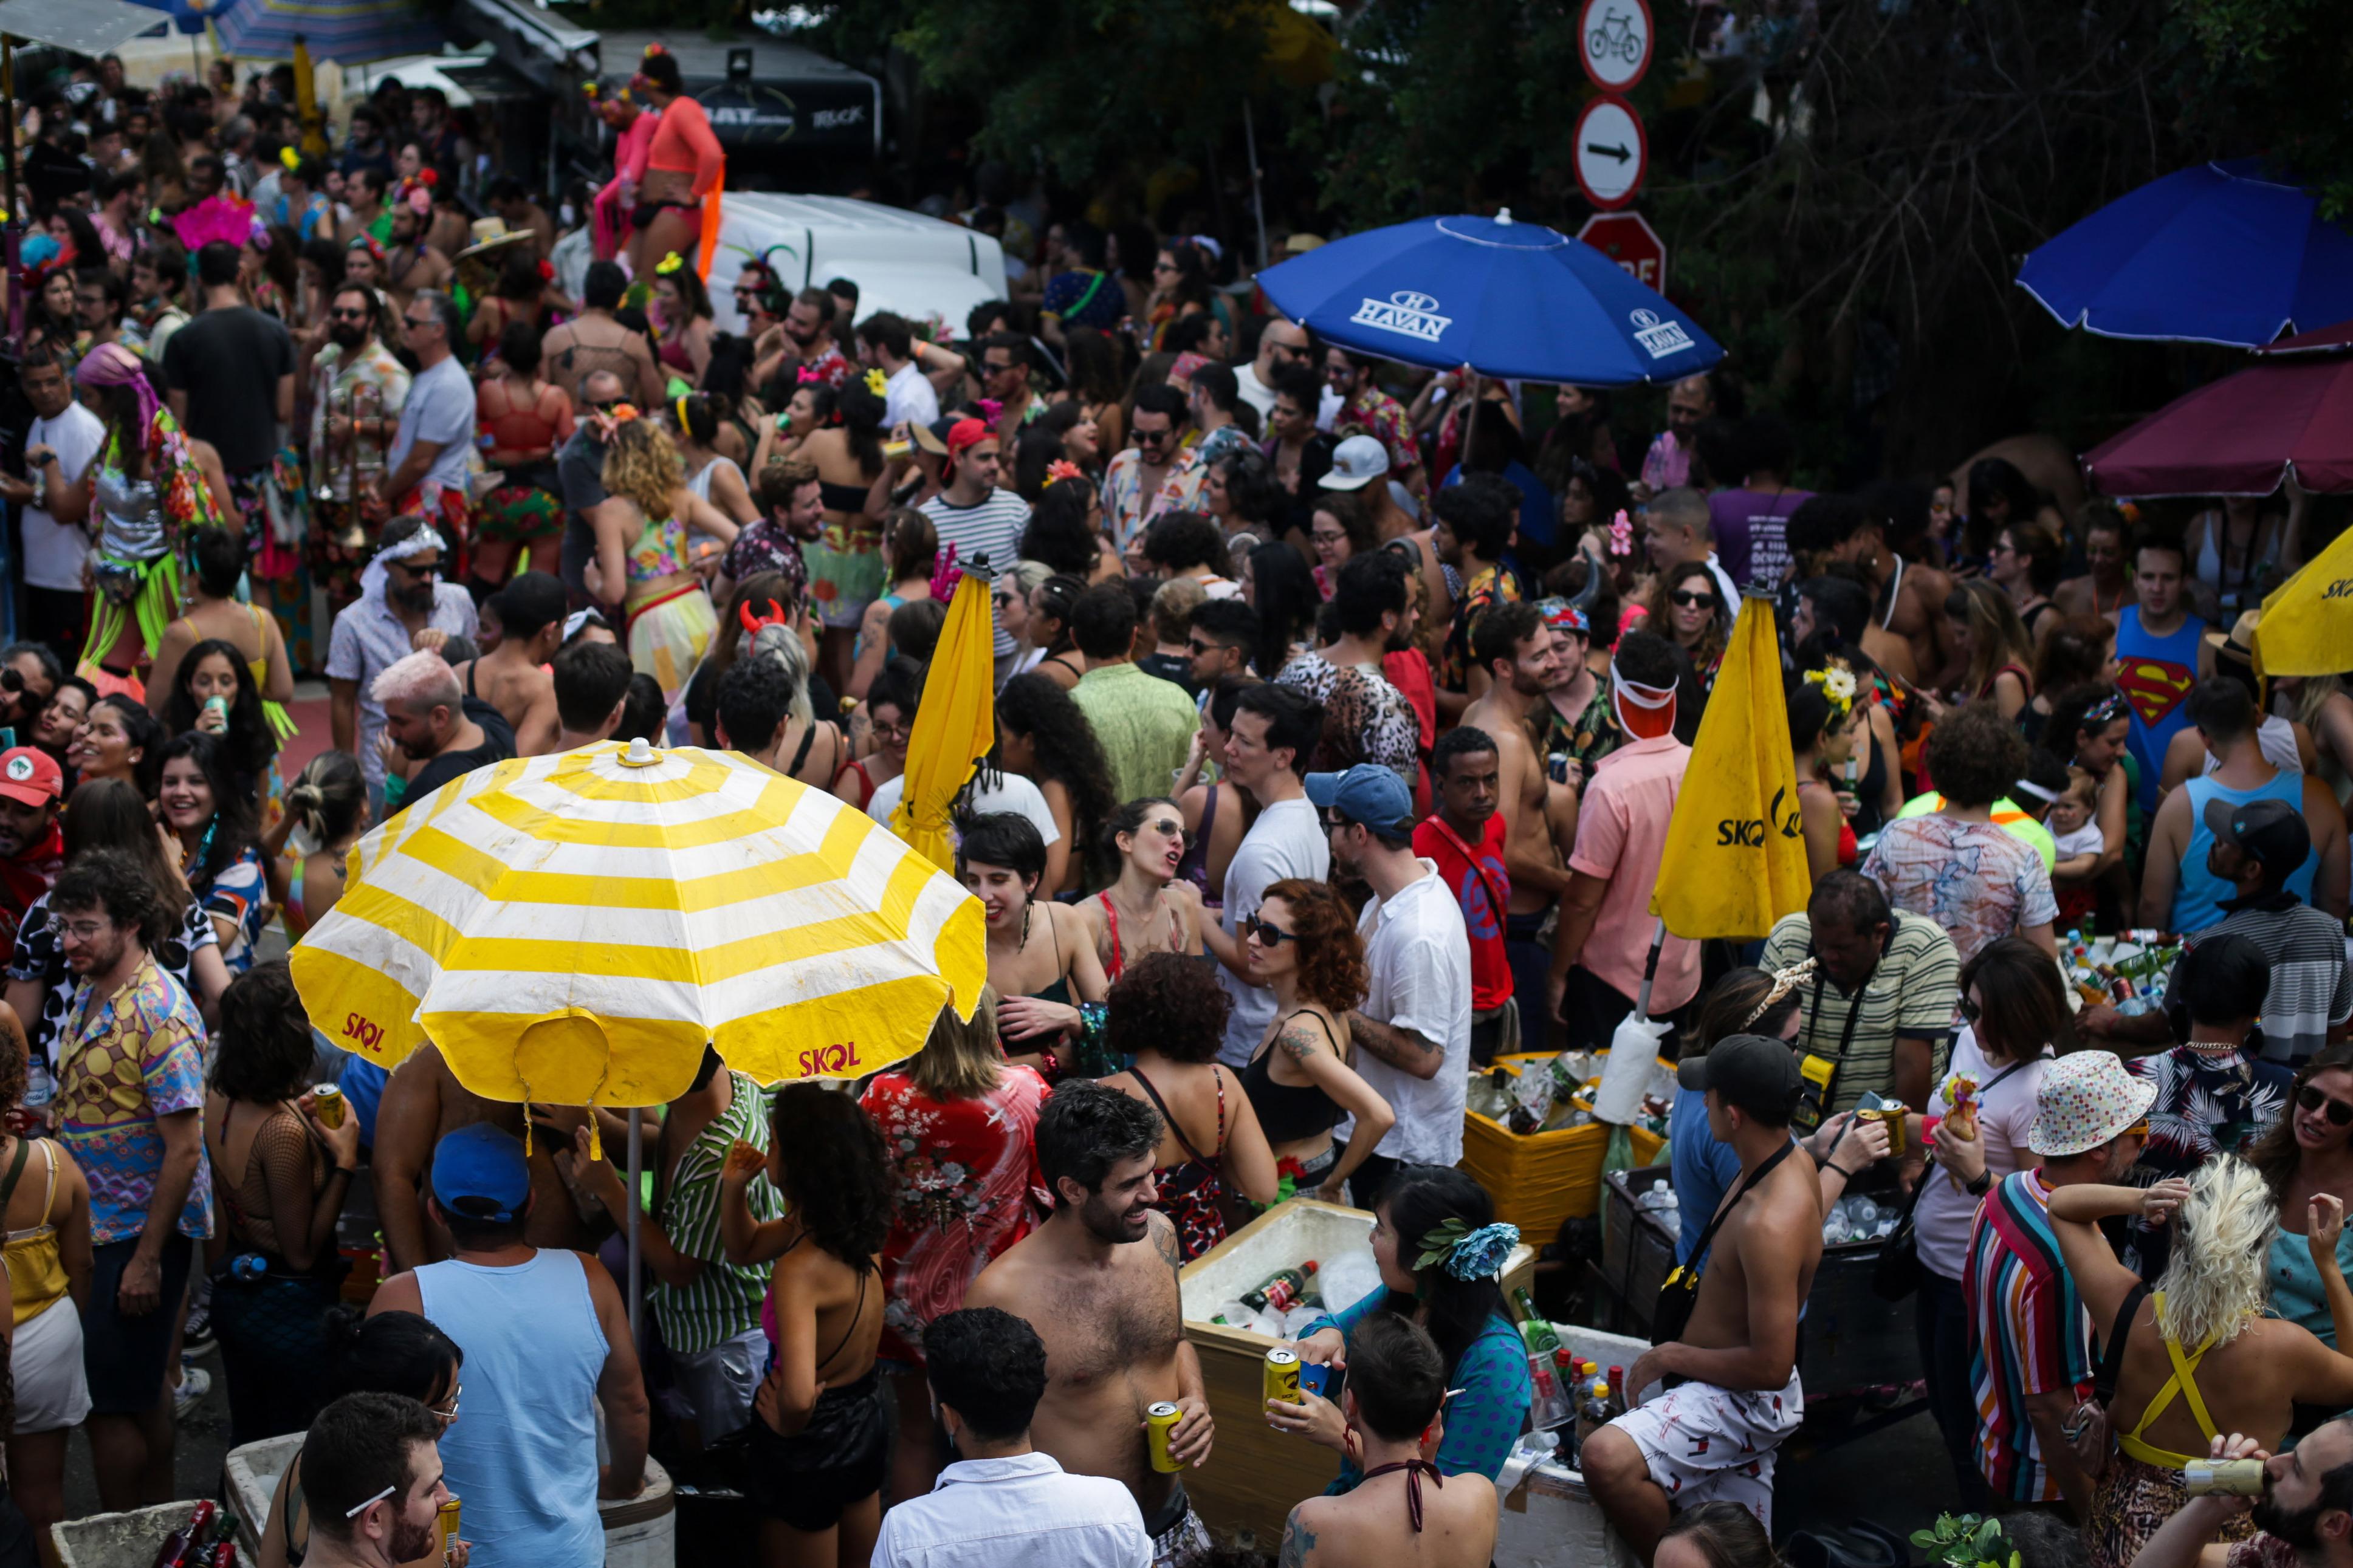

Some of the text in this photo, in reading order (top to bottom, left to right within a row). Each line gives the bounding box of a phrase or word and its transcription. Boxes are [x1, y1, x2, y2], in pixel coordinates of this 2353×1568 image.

[1355, 303, 1449, 335] HAVAN
[342, 1012, 385, 1053] SKOL
[799, 1041, 860, 1077] SKOL
